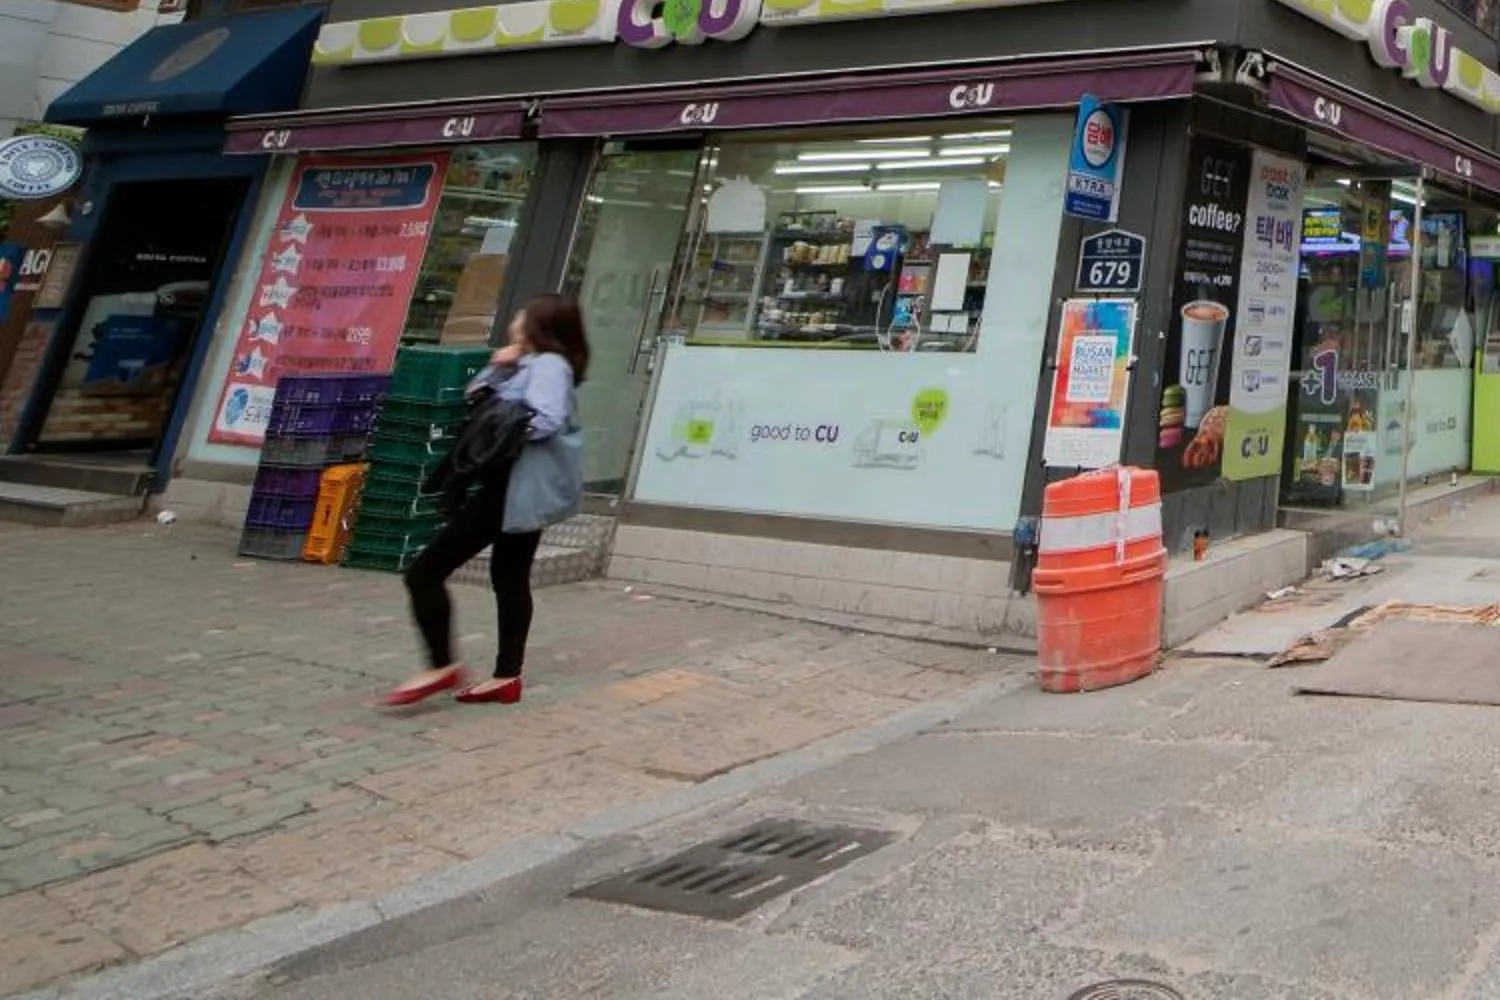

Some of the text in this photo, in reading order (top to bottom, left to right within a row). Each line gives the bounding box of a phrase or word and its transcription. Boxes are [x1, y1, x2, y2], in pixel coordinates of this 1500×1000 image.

[948, 83, 995, 109] CU
[680, 103, 719, 126] CU
[1313, 97, 1342, 126] CU
[442, 117, 476, 138] CU
[262, 130, 291, 149] CU
[1261, 166, 1289, 183] post
[1455, 155, 1473, 177] CU
[1266, 182, 1290, 201] box
[1188, 203, 1241, 233] coffee?
[1255, 215, 1295, 253] 택배
[1089, 260, 1131, 286] 679
[1186, 348, 1217, 385] GET
[751, 424, 840, 442] good to CU
